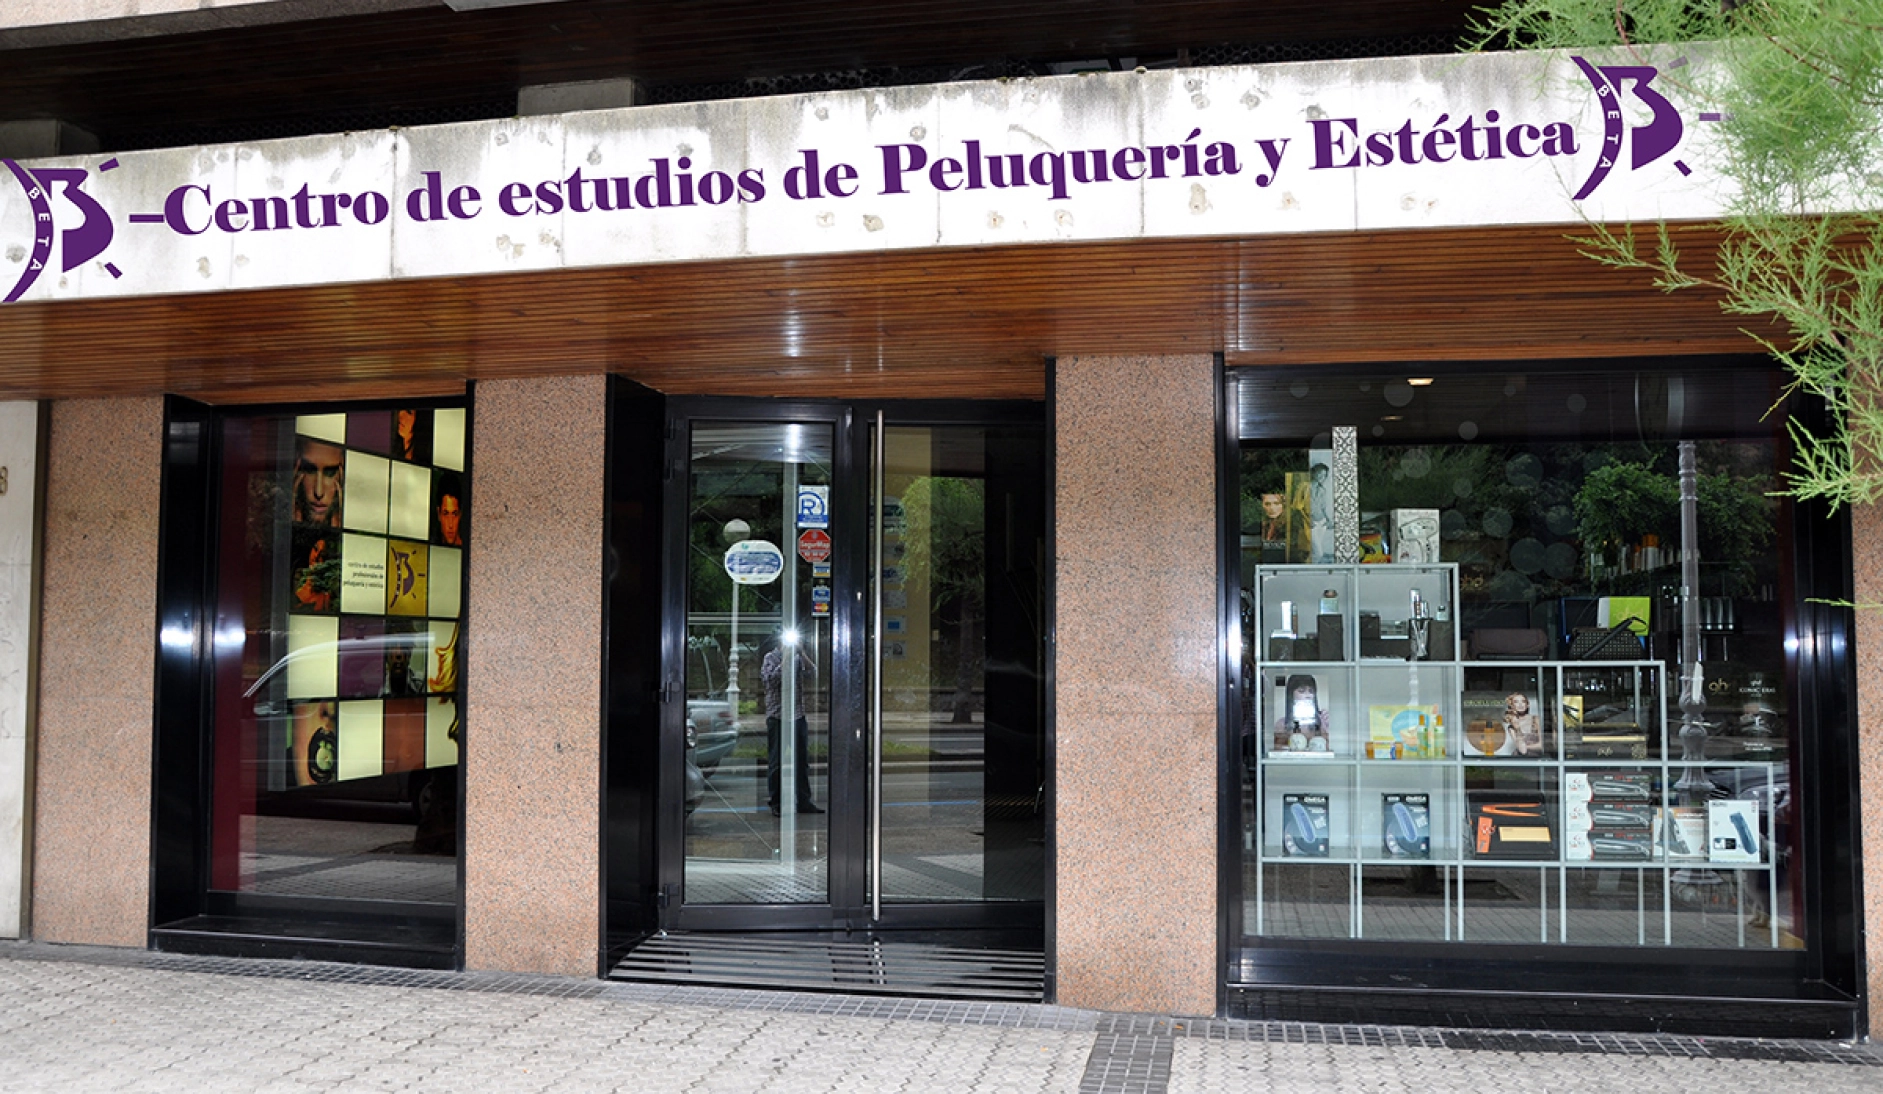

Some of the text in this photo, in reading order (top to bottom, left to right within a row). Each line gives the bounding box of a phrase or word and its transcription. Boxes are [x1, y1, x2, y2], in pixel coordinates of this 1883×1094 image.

[1596, 83, 1622, 169] BETA
[163, 109, 1581, 236] Centro de estudios de Peluquería y Estética
[27, 186, 51, 271] BETA
